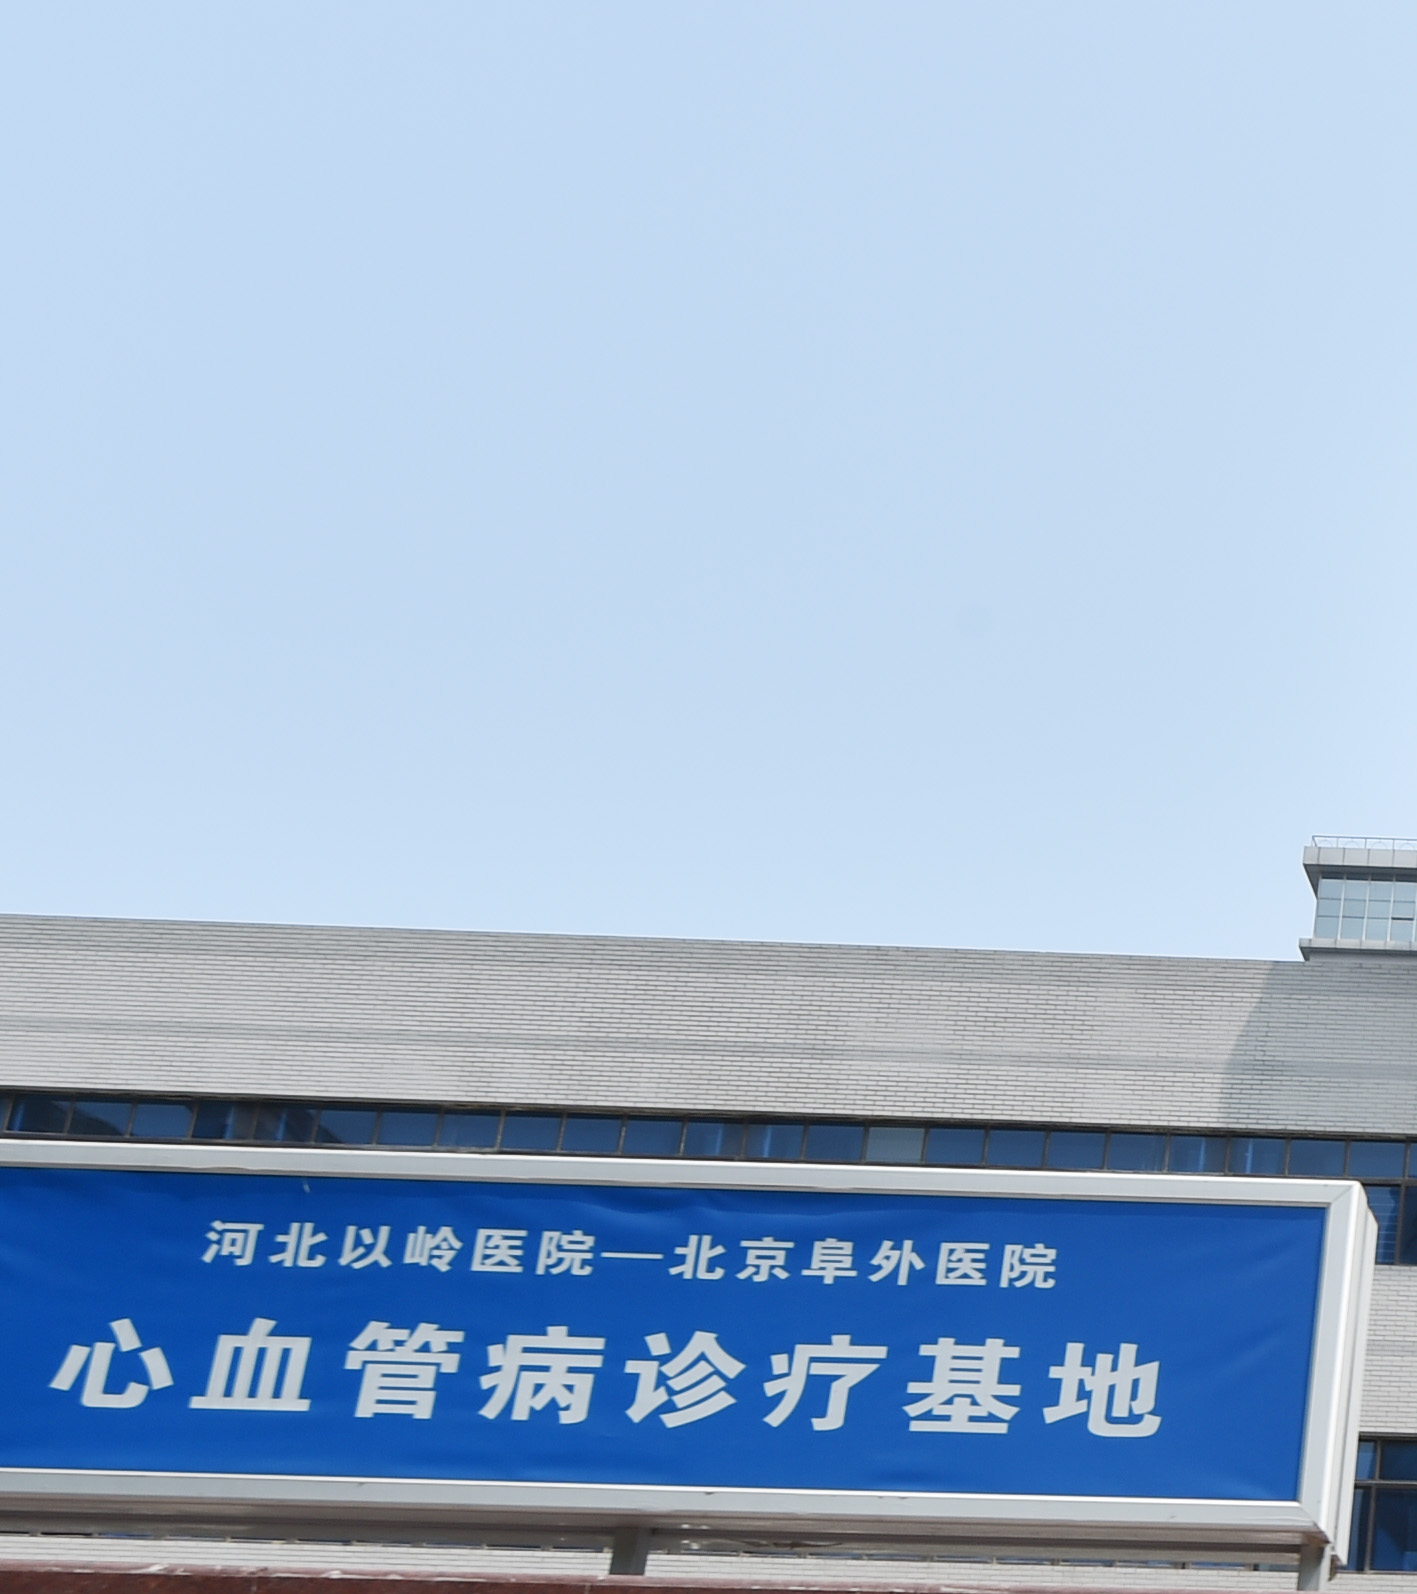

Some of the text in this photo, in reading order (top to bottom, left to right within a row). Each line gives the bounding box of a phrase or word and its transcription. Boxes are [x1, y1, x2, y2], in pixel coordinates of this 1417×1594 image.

[51, 1315, 1164, 1439] 心血管病诊疗基地
